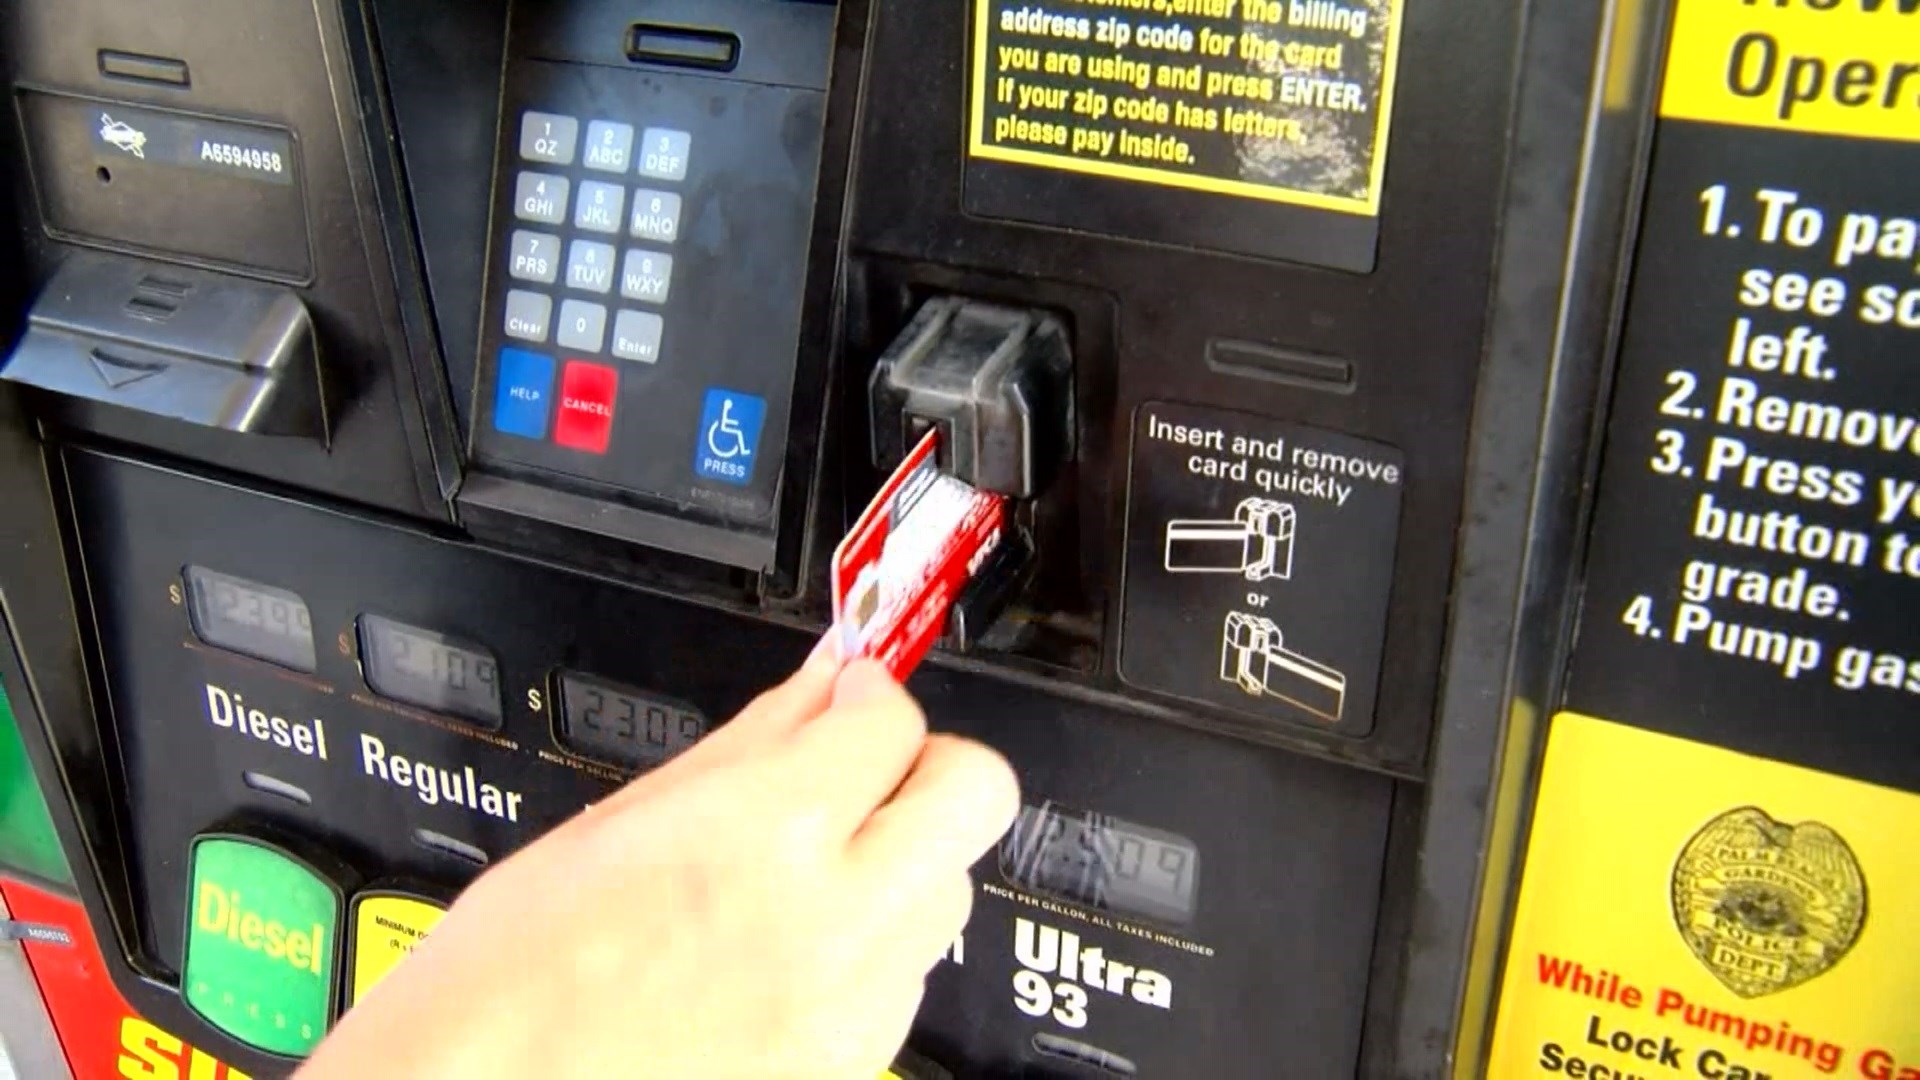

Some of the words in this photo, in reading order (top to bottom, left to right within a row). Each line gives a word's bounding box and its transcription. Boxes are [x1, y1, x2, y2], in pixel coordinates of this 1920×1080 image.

[1000, 7, 1090, 40] address
[1095, 16, 1131, 48] zip
[1136, 24, 1194, 52] code
[1199, 27, 1235, 57] for
[1239, 32, 1280, 62] the
[1284, 41, 1343, 70] card
[1242, 0, 1282, 23] the
[1288, 0, 1367, 38] billing
[998, 46, 1039, 72] you
[1044, 51, 1082, 75] are
[1087, 54, 1151, 89] using
[1156, 64, 1201, 91] and
[1206, 70, 1273, 101] press
[1279, 76, 1367, 113] ENTER.
[1727, 31, 1920, 121] Oper
[998, 77, 1015, 103] If
[1018, 84, 1068, 110] your
[1073, 89, 1107, 119] zip
[1113, 97, 1169, 124] code
[1175, 100, 1218, 130] has
[534, 138, 558, 156] QZ
[544, 122, 551, 136] 1
[604, 129, 614, 145] 2
[659, 136, 670, 152] 3
[995, 114, 1066, 142] please
[1071, 128, 1114, 156] pay
[1119, 129, 1196, 164] inside.
[201, 140, 282, 173] A6594958
[588, 146, 624, 165] ABC
[646, 154, 680, 173] DEF
[524, 197, 554, 216] GHI
[536, 180, 545, 196] 4
[582, 206, 612, 225] JKL
[634, 213, 674, 234] MNO
[1699, 184, 1741, 238] 1.
[1756, 188, 1824, 248] To
[1834, 211, 1920, 276] pa
[515, 256, 547, 275] PRS
[530, 239, 540, 254] 7
[573, 265, 606, 284] TUV
[626, 275, 664, 294] WXY
[1738, 267, 1848, 317] see
[509, 317, 542, 336] Clear
[576, 317, 587, 333] 0
[618, 336, 653, 355] Enter
[1727, 317, 1837, 380] left.
[510, 386, 540, 400] HELP
[562, 397, 612, 416] CANCEL
[1659, 370, 1705, 419] 2.
[704, 458, 745, 478] PRESS
[1148, 414, 1224, 451] Insert
[1231, 438, 1283, 463] and
[1291, 448, 1399, 484] remove
[1650, 429, 1694, 478] 3.
[1704, 436, 1864, 506] Press
[1188, 456, 1247, 482] card
[1255, 470, 1352, 506] quickly
[1693, 493, 1869, 566] button
[1247, 593, 1269, 607] or
[1682, 559, 1850, 622] grade.
[1622, 594, 1662, 639] 4.
[1672, 602, 1822, 679] Pump
[206, 684, 328, 760] Diesel
[360, 732, 522, 822] Regular
[197, 881, 325, 976] Diesel
[983, 883, 1015, 900] PRICE
[1017, 893, 1039, 907] PER
[1041, 901, 1089, 924] GALLON,
[1091, 916, 1113, 930] ALL
[1115, 923, 1152, 940] TAXES
[1154, 934, 1215, 957] INCLUDED
[1014, 917, 1172, 1010] Ultra
[1012, 969, 1088, 1029] 93
[1537, 953, 1643, 1009] While
[1656, 988, 1843, 1074] Pumping
[1587, 1015, 1683, 1070] Lock
